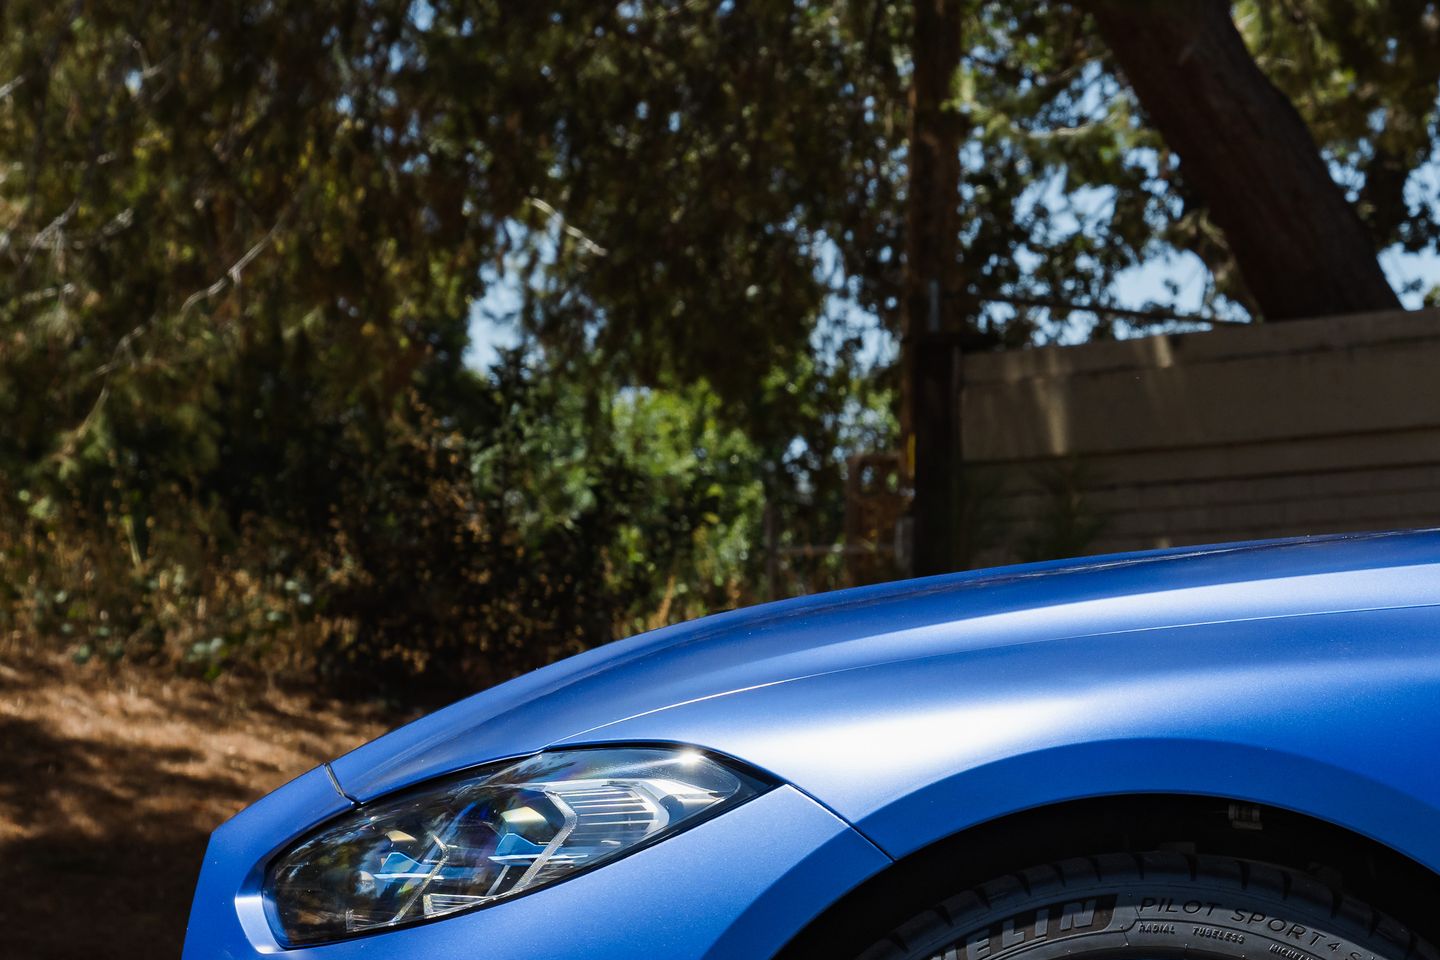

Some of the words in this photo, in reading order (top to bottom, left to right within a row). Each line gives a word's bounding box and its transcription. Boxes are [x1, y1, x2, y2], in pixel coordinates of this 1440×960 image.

[1138, 897, 1225, 918] PILOT
[1228, 904, 1327, 950] SPORT
[1138, 923, 1176, 934] RADIAL
[1191, 926, 1245, 945] TUBELESS
